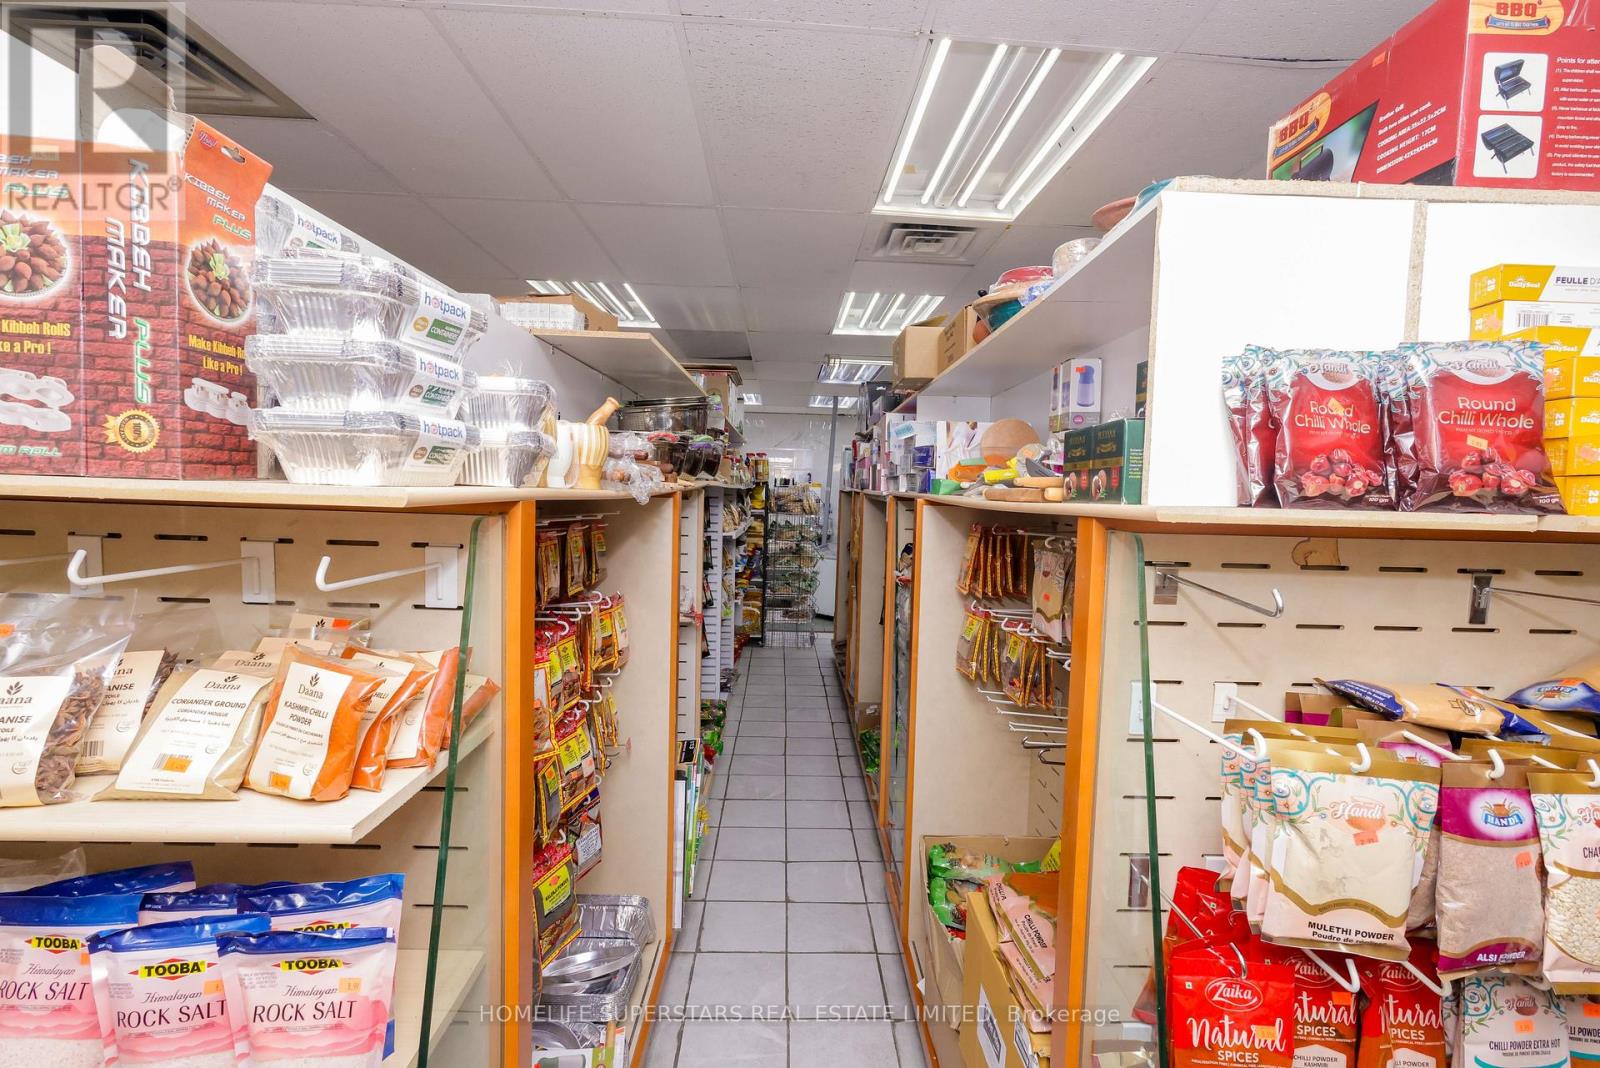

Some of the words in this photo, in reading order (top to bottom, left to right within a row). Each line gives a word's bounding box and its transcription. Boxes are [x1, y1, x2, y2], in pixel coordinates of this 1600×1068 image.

[1495, 2, 1538, 18] BBQ
[1279, 110, 1310, 143] BBQ
[184, 172, 231, 202] KIBBEH
[207, 196, 246, 222] MAKER
[128, 158, 152, 293] KIBBEH
[212, 214, 253, 241] PLUS
[296, 214, 339, 245] hotpack
[104, 216, 128, 341] MAKER
[1555, 276, 1589, 285] FEULLE
[424, 291, 467, 320] hotpack
[1, 319, 41, 335] Kibbeh
[13, 341, 21, 353] a
[23, 340, 45, 355] Pro
[188, 334, 212, 352] Make
[132, 317, 152, 405] PLUS
[203, 355, 219, 371] Like
[220, 362, 226, 373] a
[226, 361, 240, 376] Pro
[419, 357, 461, 381] hotpack
[1457, 396, 1517, 412] Round
[1294, 414, 1326, 430] Chilli
[1327, 417, 1371, 434] Whole
[1438, 410, 1476, 426] Chilli
[1479, 413, 1535, 430] Whole
[423, 420, 464, 441] hotpack
[234, 659, 273, 669] Daana
[204, 680, 242, 691] Daana
[297, 683, 325, 700] Daana
[171, 698, 214, 707] CORIANDER
[214, 700, 247, 709] GROUND
[283, 700, 310, 715] KASHMIRI
[308, 708, 330, 720] CHILLI
[288, 713, 313, 727] POWDER
[1330, 800, 1385, 820] Handi
[1486, 815, 1520, 827] HANDI
[1024, 914, 1037, 932] CHILLI
[1033, 929, 1048, 949] POWDER
[1307, 921, 1352, 936] MULETHI
[1354, 930, 1395, 941] POWDER
[1312, 930, 1342, 942] Poudre
[35, 936, 79, 950] TOOBA
[284, 959, 340, 971] TOOBA
[1476, 952, 1498, 962] ALSI
[23, 962, 76, 980] Himalayan
[143, 961, 204, 977] TOOBA
[45, 981, 90, 1001] SALT
[141, 989, 202, 1004] Himalayan
[283, 984, 338, 1001] Himalayan
[1208, 981, 1259, 1008] Zaika
[116, 1007, 171, 1029] ROCK
[178, 999, 227, 1023] SALT
[252, 1003, 306, 1024] ROCK
[312, 1000, 358, 1021] SALT
[1186, 1014, 1287, 1052] Natural
[1296, 1024, 1337, 1038] SPICES
[1488, 1041, 1509, 1051] CHILLI
[1509, 1040, 1533, 1050] POWDER
[1533, 1040, 1550, 1049] EXTRA
[1550, 1039, 1561, 1049] HOT
[1217, 1049, 1260, 1064] SPICES
[1312, 1055, 1338, 1063] POWDER
